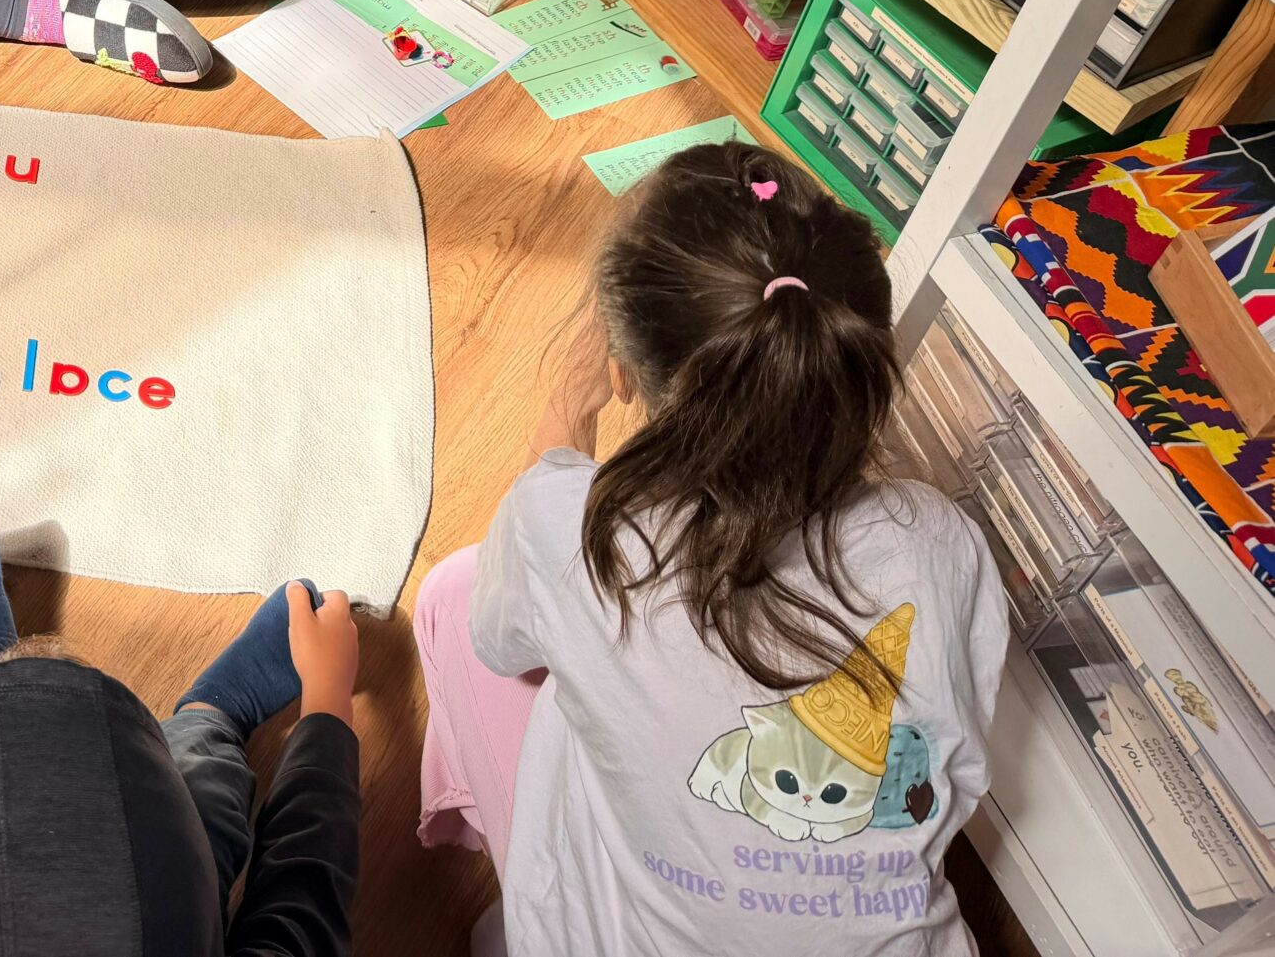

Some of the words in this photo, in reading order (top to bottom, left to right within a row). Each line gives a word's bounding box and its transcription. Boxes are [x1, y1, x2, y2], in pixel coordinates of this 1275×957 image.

[540, 6, 563, 25] punch
[552, 4, 572, 21] lunch
[561, 0, 582, 18] bench
[517, 18, 534, 32] inch
[526, 15, 544, 29] such
[534, 10, 554, 28] ranch
[509, 22, 525, 36] chip
[592, 31, 607, 45] ship
[548, 40, 568, 58] finish
[571, 37, 587, 52] wish
[579, 34, 595, 47] fish
[540, 43, 558, 61] mesh
[595, 73, 613, 91] math
[604, 70, 624, 88] theft
[614, 67, 633, 85] moth
[622, 62, 647, 85] thread
[564, 81, 585, 101] tooth
[573, 77, 595, 99] mouth
[585, 75, 603, 93] thick
[534, 91, 553, 109] bath
[544, 88, 566, 106] think
[556, 86, 572, 101] thin
[597, 167, 613, 182] rule
[604, 163, 624, 180] pure
[617, 161, 635, 178] tune
[1093, 597, 1107, 616] Parts
[1154, 691, 1168, 711] Parts
[1121, 742, 1143, 773] you.
[1142, 738, 1162, 768] who
[1211, 785, 1226, 807] Parts
[1199, 814, 1238, 868] around
[733, 844, 866, 884] serving
[877, 847, 916, 878] up
[643, 850, 726, 901] some
[738, 886, 844, 918] sweet
